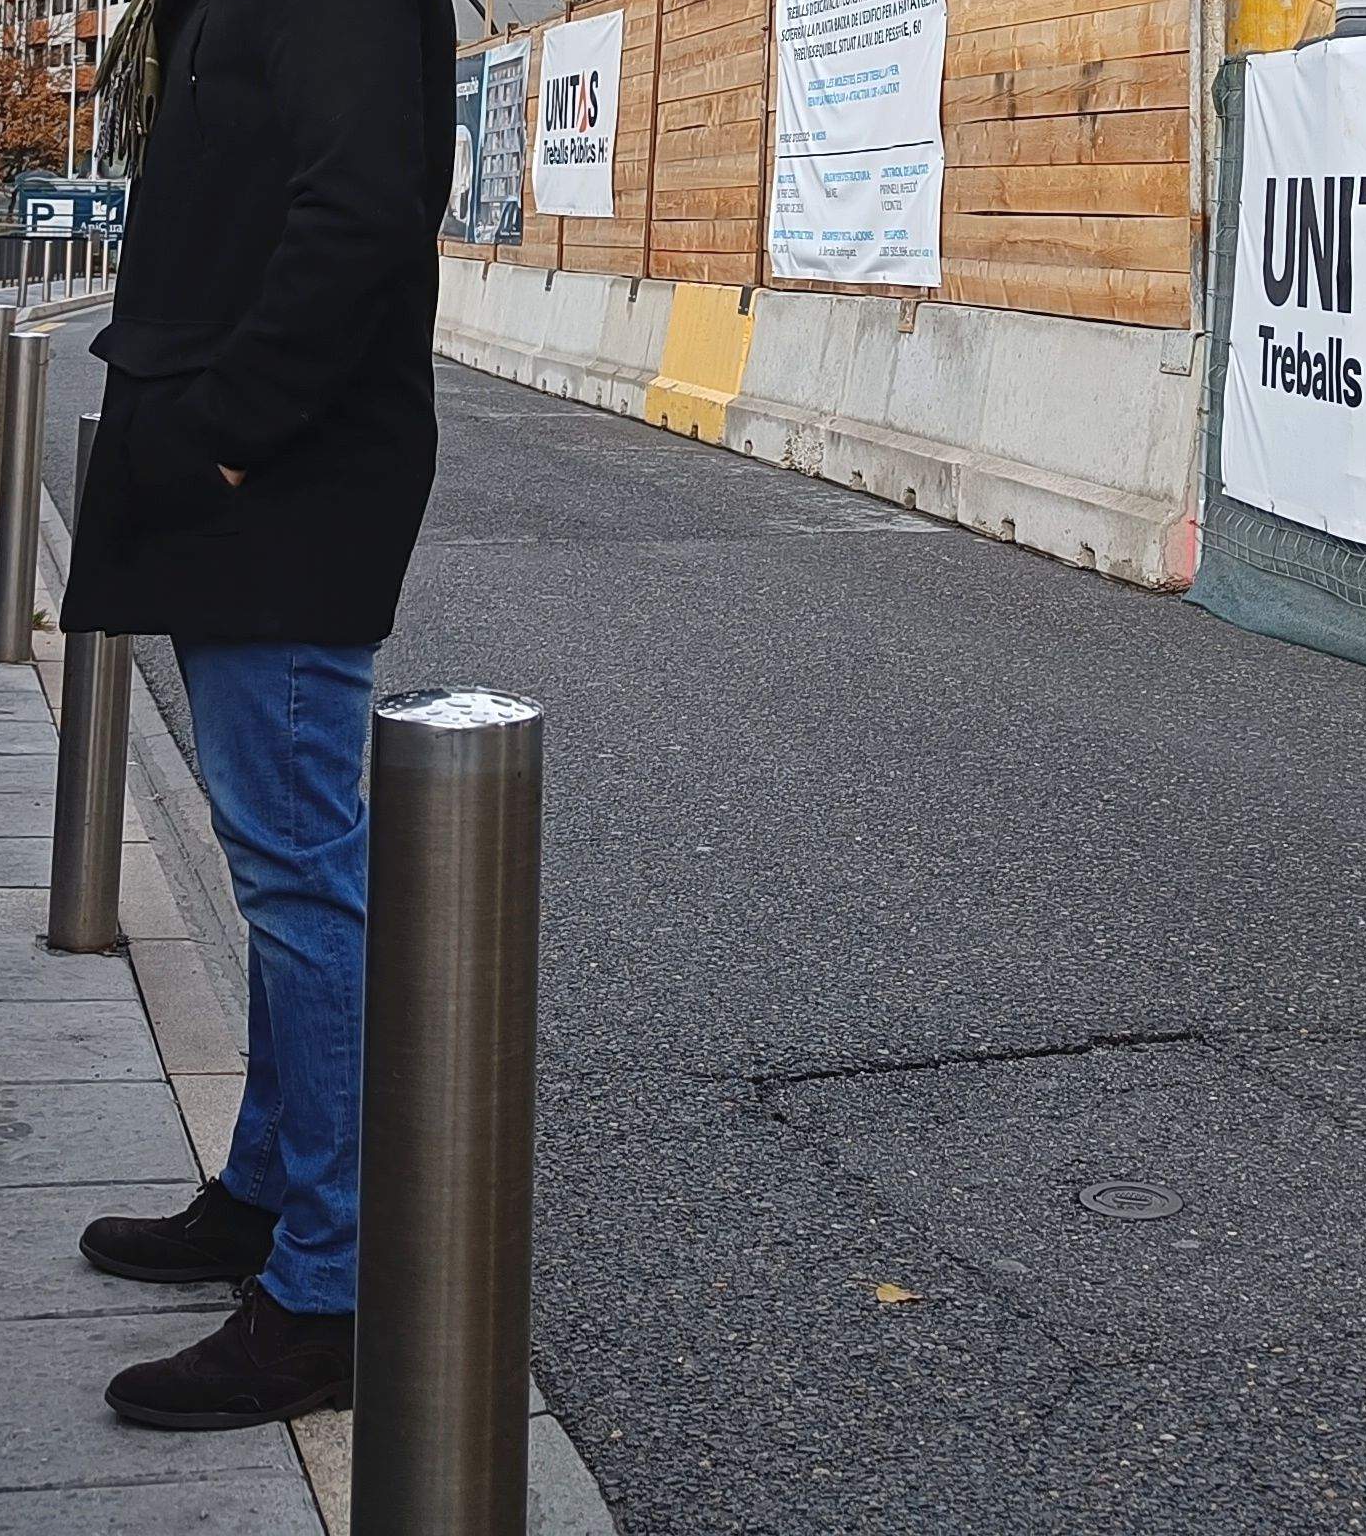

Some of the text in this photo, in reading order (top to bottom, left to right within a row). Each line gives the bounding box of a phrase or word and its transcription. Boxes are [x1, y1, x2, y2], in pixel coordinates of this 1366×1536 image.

[546, 70, 599, 133] UNITAS
[32, 203, 54, 232] P
[1258, 324, 1363, 408] Treballs
